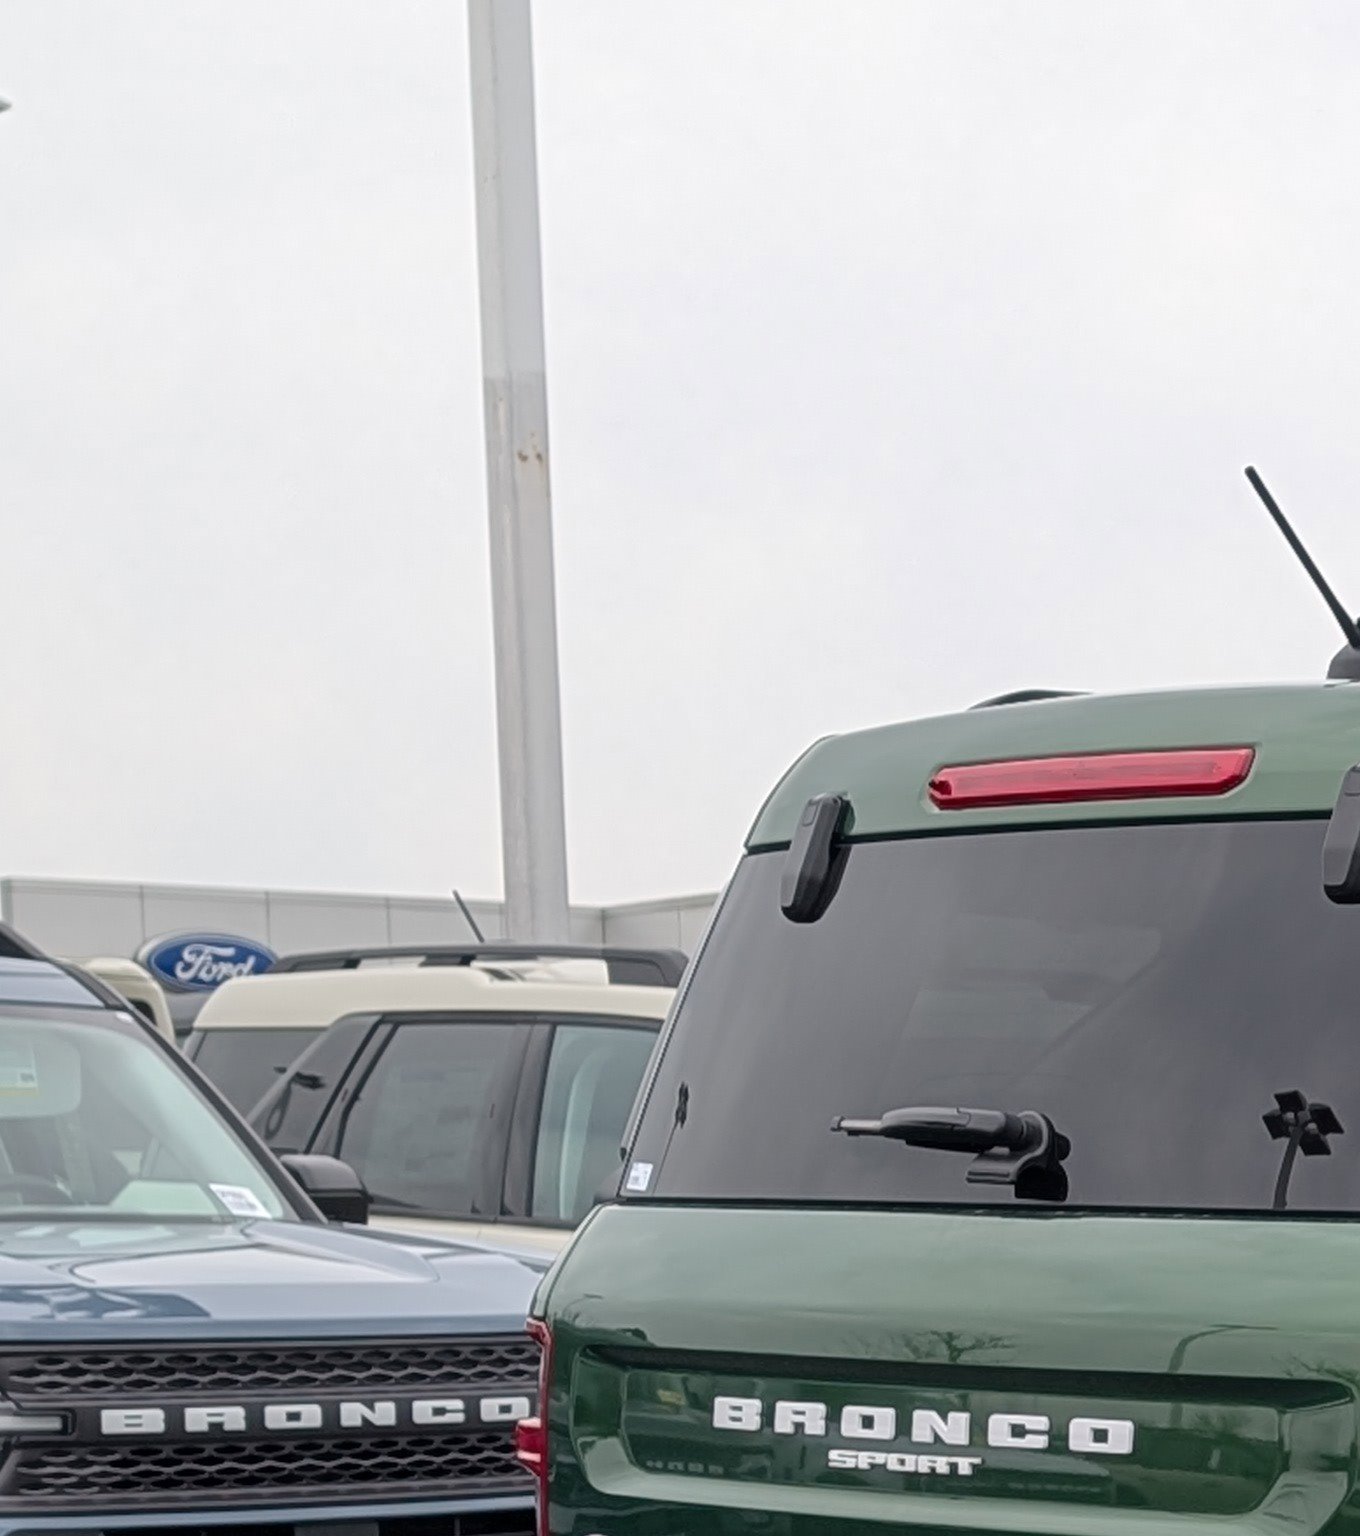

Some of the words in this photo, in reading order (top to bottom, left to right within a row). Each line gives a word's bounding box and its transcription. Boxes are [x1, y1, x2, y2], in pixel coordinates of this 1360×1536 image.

[174, 943, 256, 983] Ford
[100, 1396, 531, 1436] BRONCO
[712, 1395, 1135, 1455] BRONCO
[828, 1449, 982, 1476] SPORT
